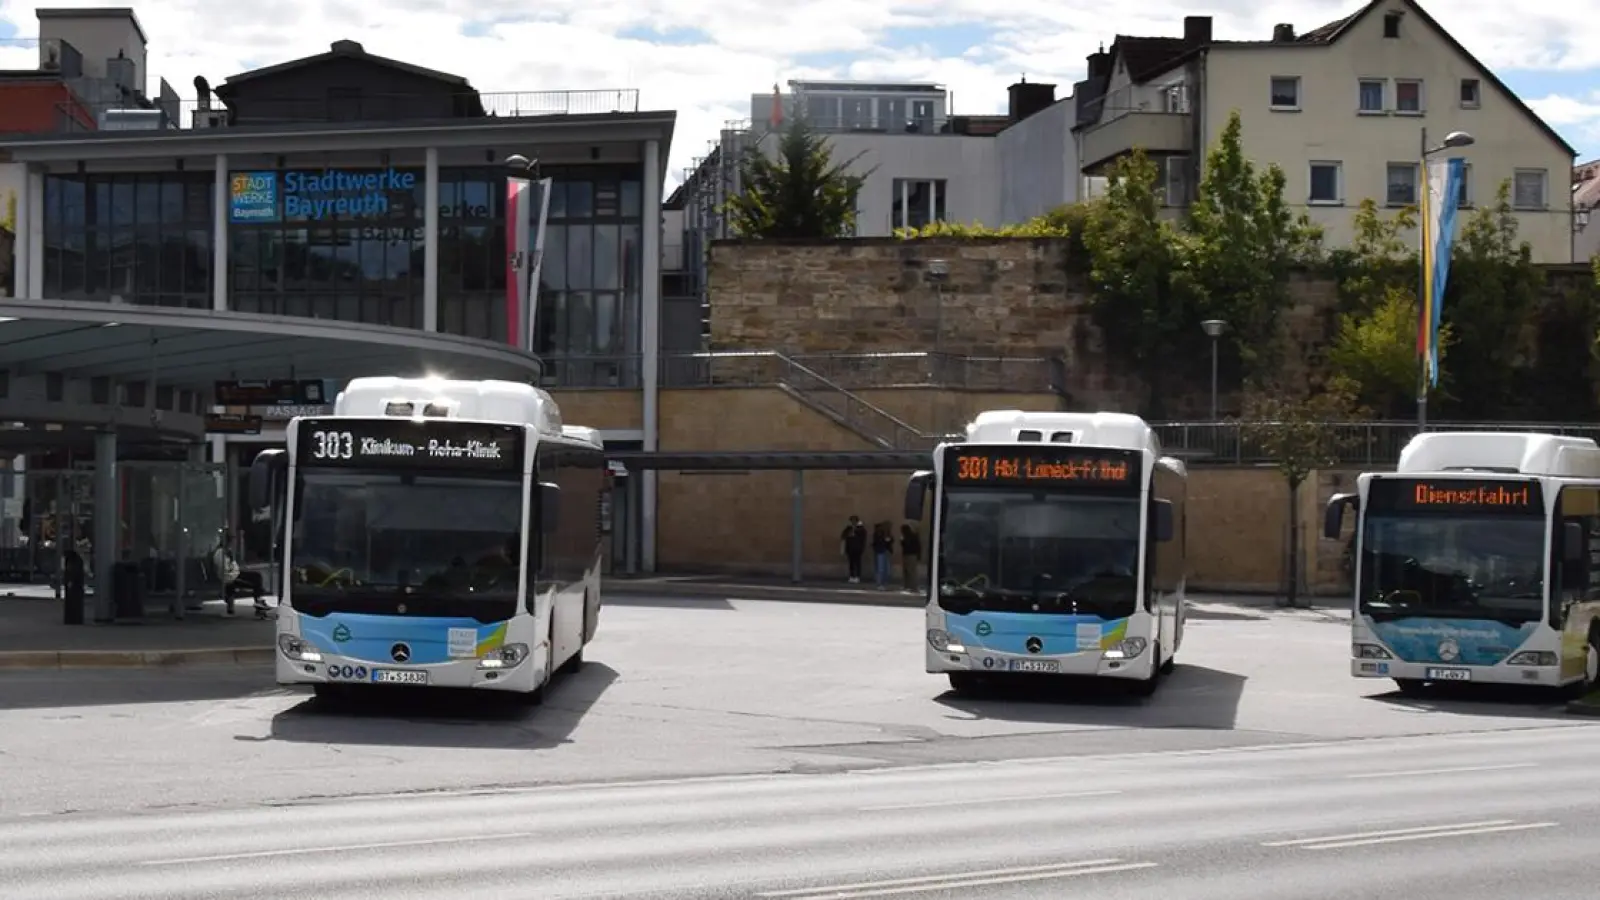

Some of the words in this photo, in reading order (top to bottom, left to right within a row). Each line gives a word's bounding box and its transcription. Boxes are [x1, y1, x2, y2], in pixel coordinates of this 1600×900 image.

[232, 177, 273, 191] STADT
[284, 168, 415, 192] Stadtwerke
[284, 192, 388, 220] Bayreuth
[266, 405, 324, 417] PASSAGE
[313, 430, 353, 459] 303
[360, 437, 414, 456] Klinikum
[958, 456, 989, 479] 301
[1415, 483, 1528, 506] Dienstfahrt
